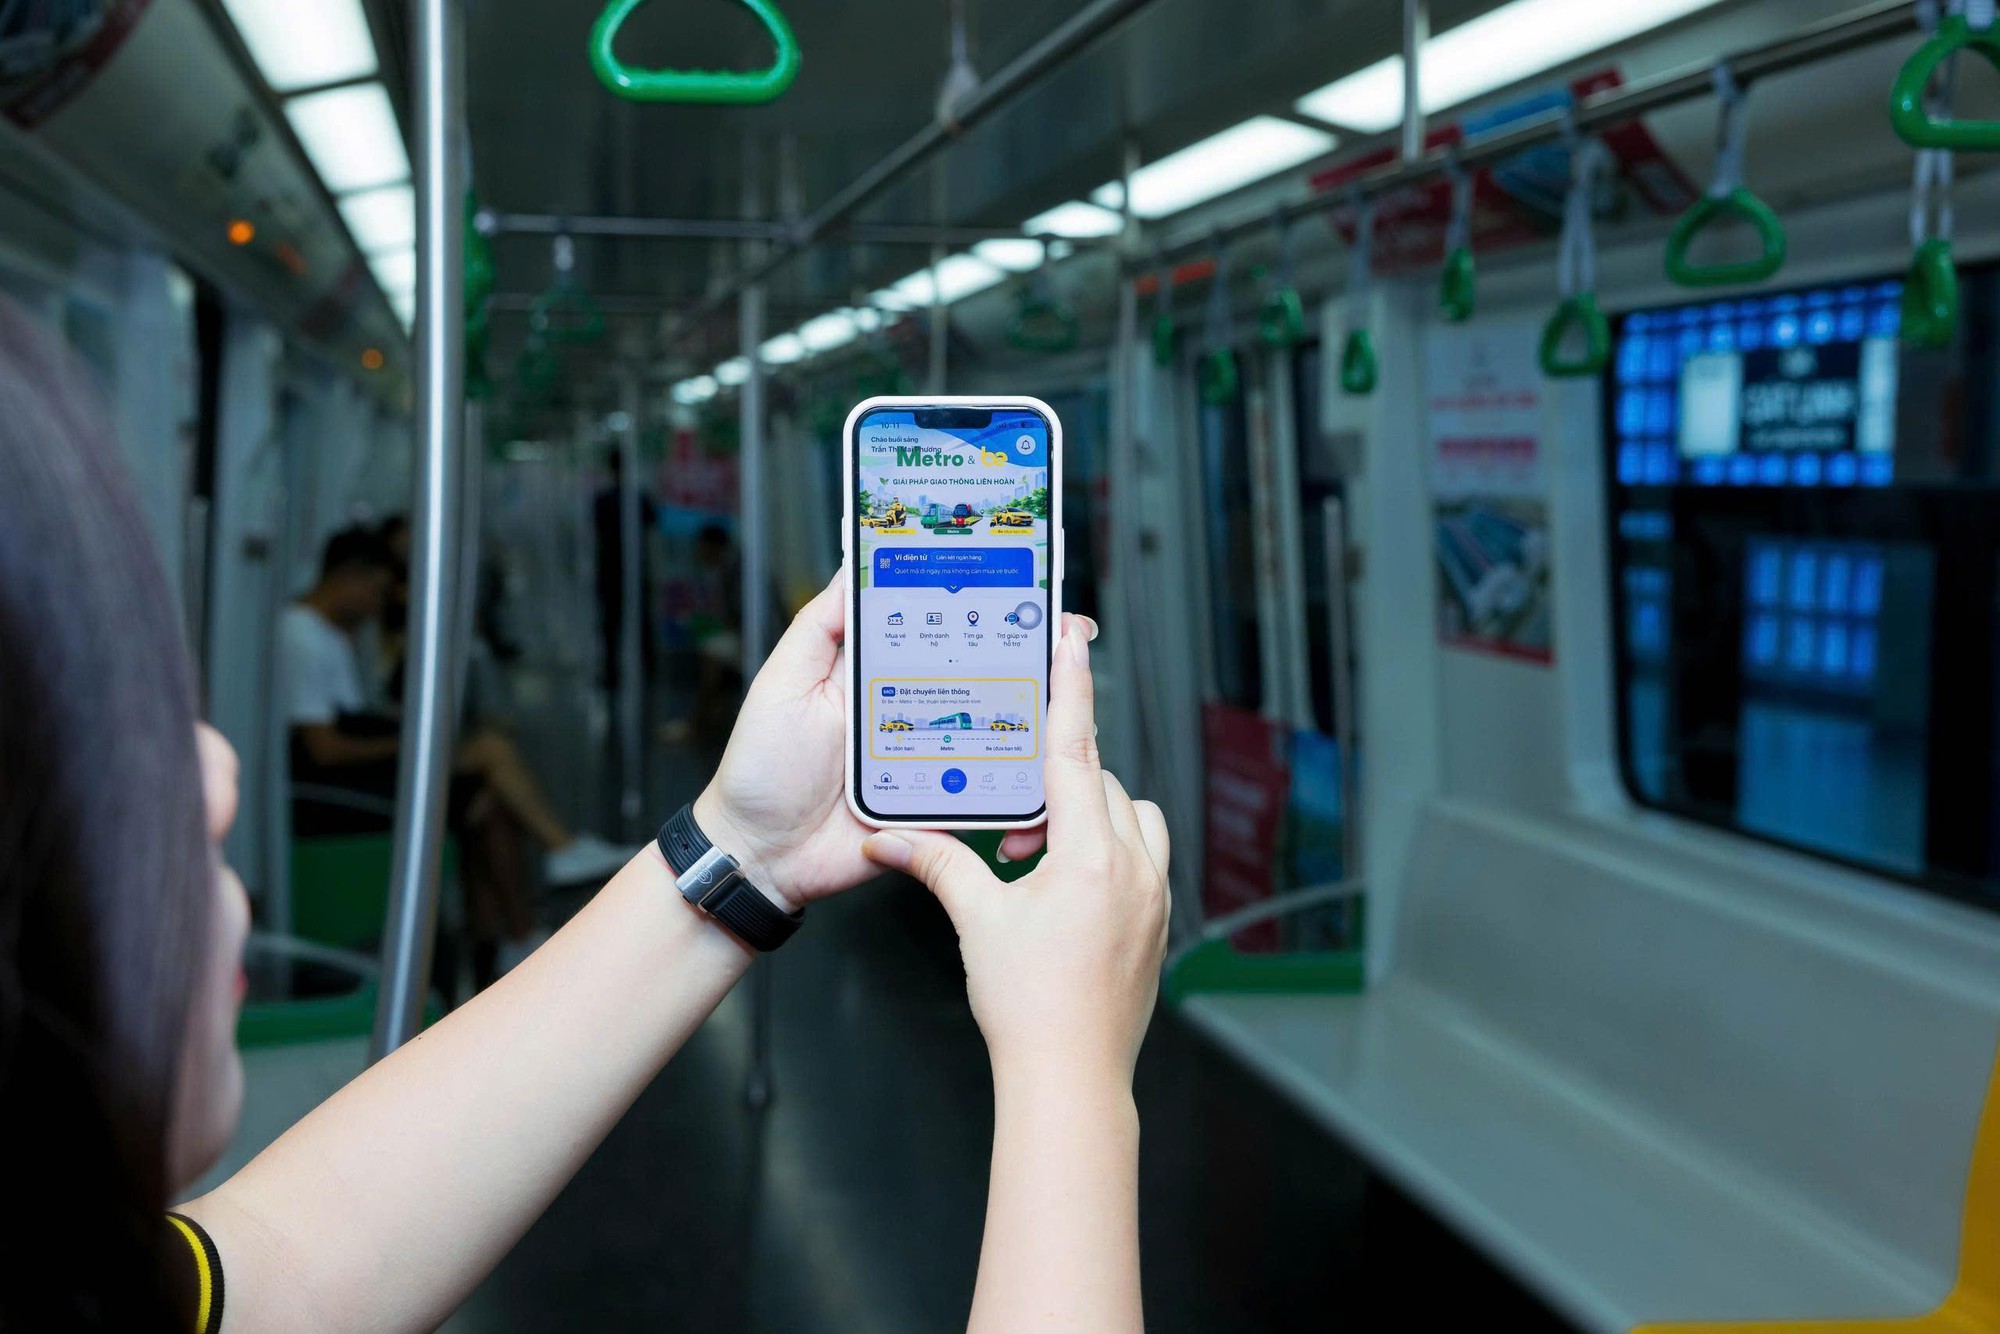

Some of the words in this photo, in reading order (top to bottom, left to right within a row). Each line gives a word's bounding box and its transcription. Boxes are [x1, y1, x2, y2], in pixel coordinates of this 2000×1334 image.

[903, 436, 918, 444] sáng
[896, 446, 964, 467] Metro
[968, 455, 976, 464] &
[981, 446, 1008, 468] be
[949, 477, 975, 485] THÔNG
[976, 477, 992, 485] LIÊN
[994, 476, 1015, 485] HOÀN
[903, 554, 918, 562] điện
[912, 688, 936, 696] chuyến
